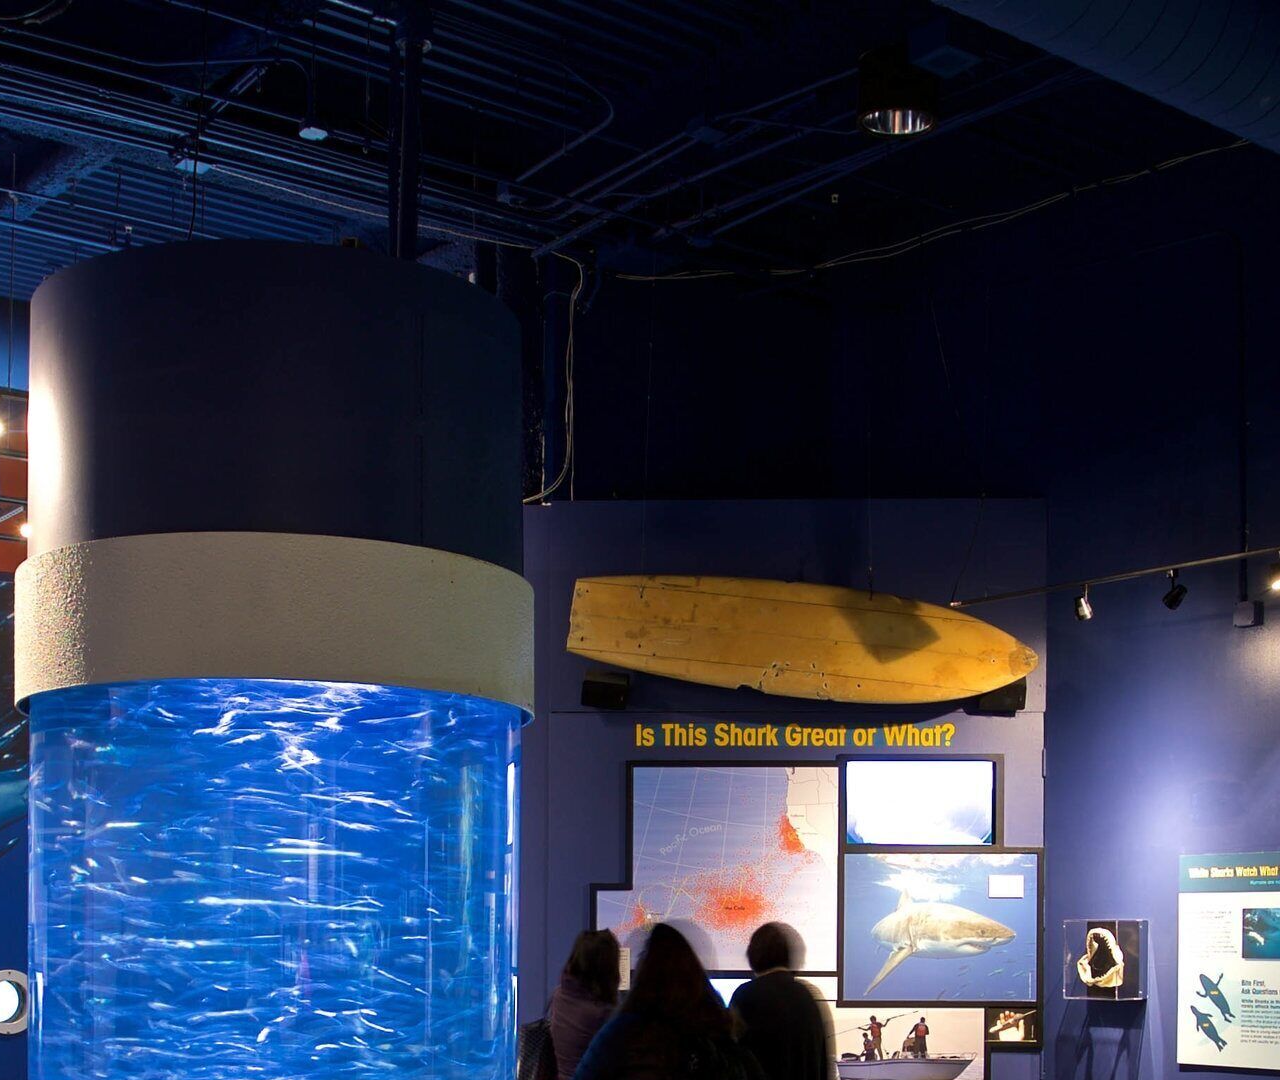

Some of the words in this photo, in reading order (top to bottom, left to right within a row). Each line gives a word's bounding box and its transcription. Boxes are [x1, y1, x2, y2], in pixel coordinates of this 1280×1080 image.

[635, 723, 655, 747] Is
[662, 723, 708, 747] This
[714, 722, 780, 747] Shark
[785, 723, 847, 747] Great
[852, 727, 877, 747] or
[883, 722, 956, 747] What?
[1210, 866, 1234, 878] Sharks
[1235, 865, 1258, 877] Watch
[1260, 865, 1278, 877] What
[1252, 987, 1278, 995] Questions
